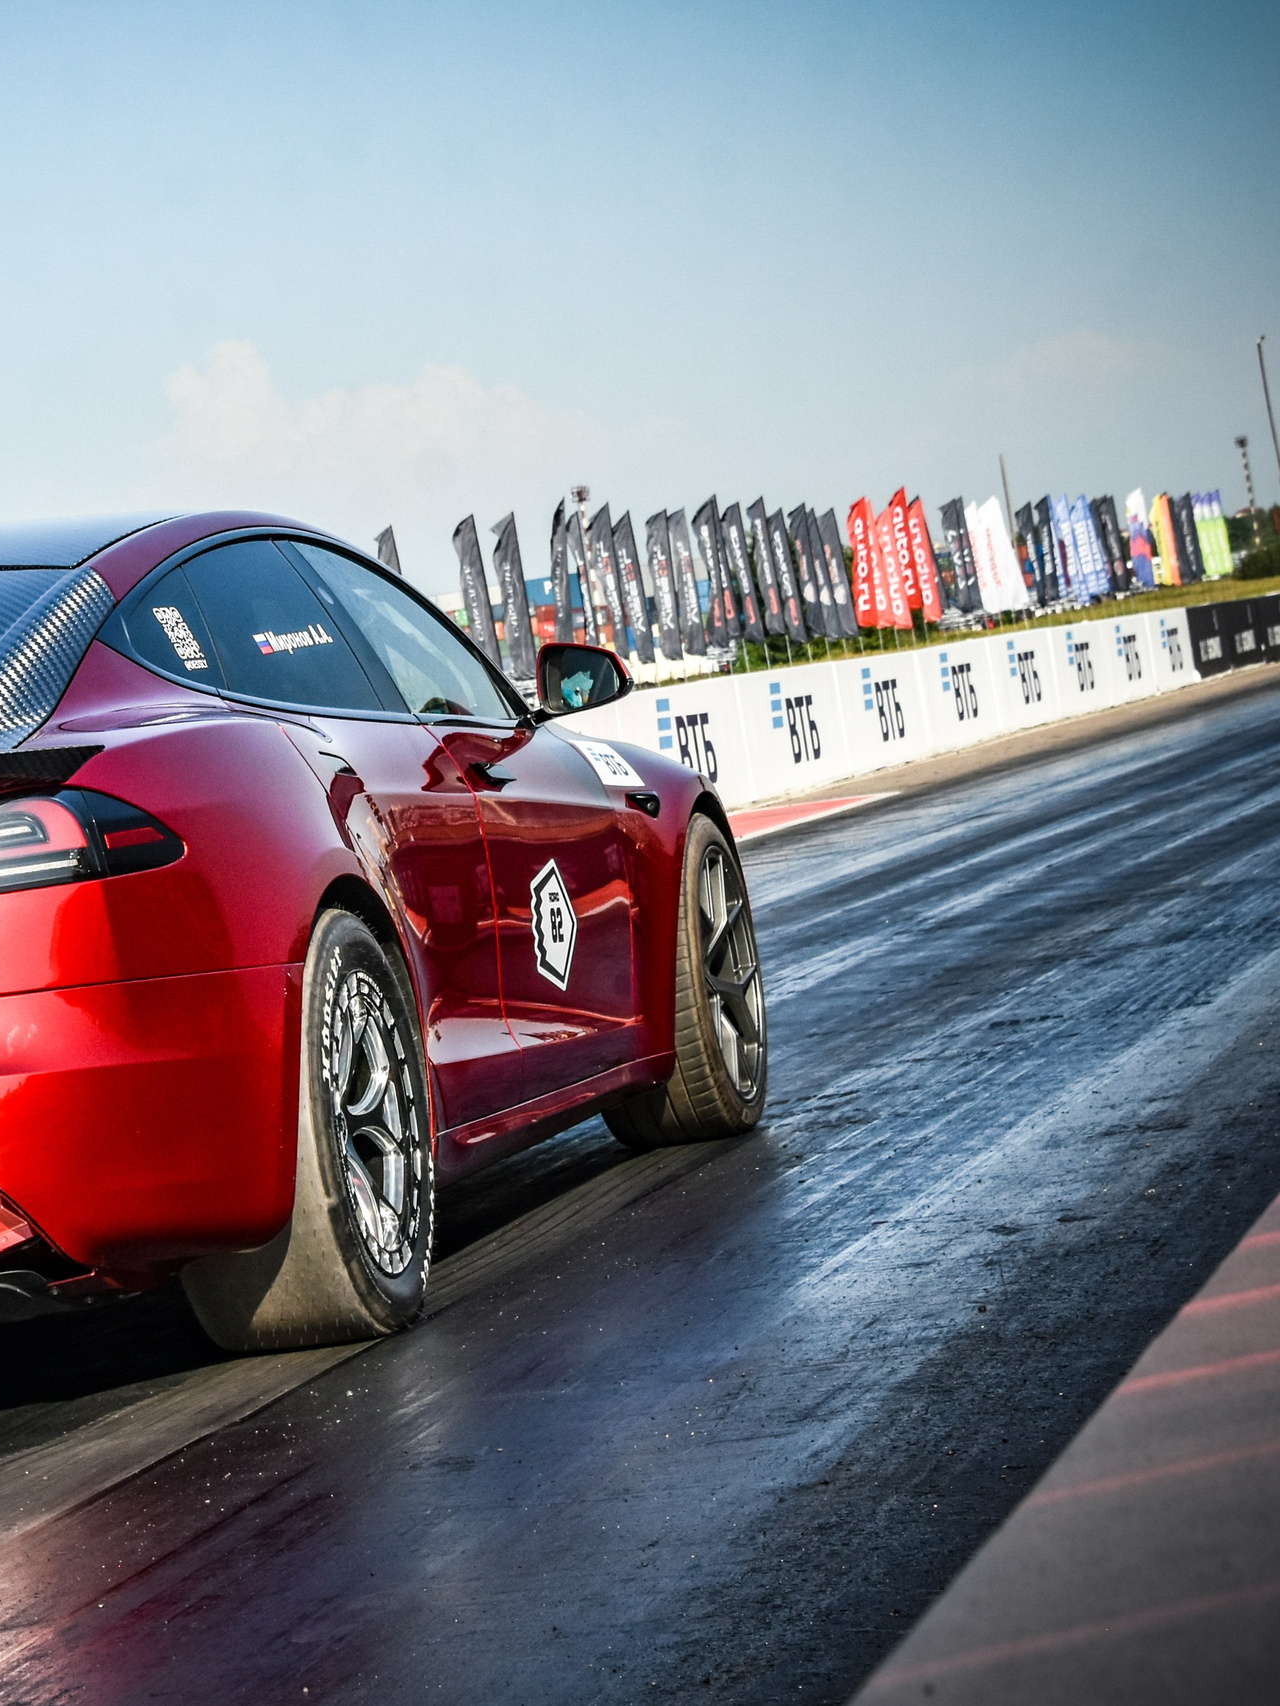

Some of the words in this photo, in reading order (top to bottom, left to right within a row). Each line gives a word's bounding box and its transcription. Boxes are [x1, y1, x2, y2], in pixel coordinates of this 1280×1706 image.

[892, 506, 916, 595] auto.ru
[1075, 642, 1095, 692] ВТБ
[1123, 634, 1142, 681] ВТБ
[1166, 628, 1183, 672] ВТБ
[951, 663, 978, 721] ВТБ
[1017, 651, 1041, 704] ВТБ
[785, 694, 821, 764] ВТБ
[874, 679, 905, 742] ВТБ
[598, 753, 629, 776] ВТБ
[675, 712, 718, 784] ВТБ
[549, 907, 565, 943] 82
